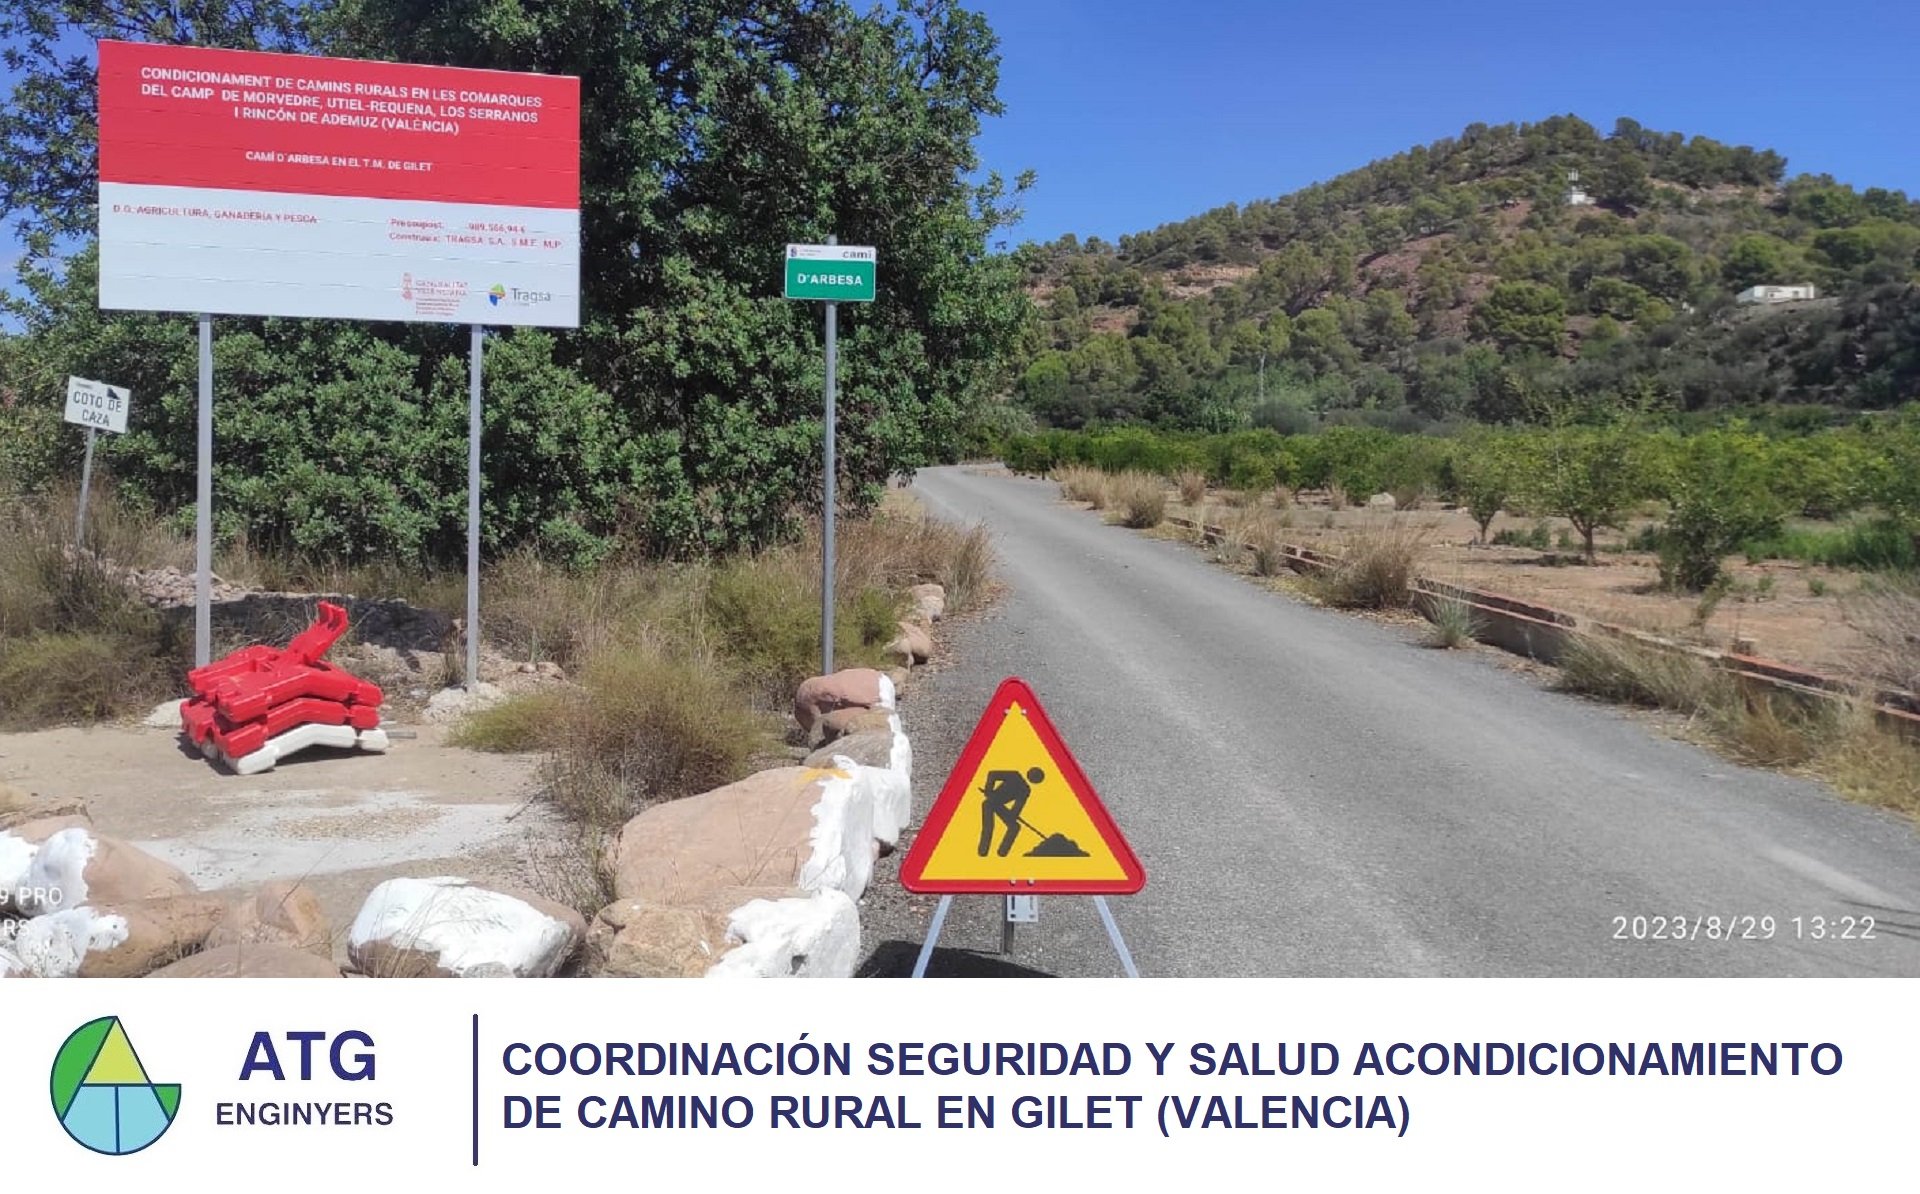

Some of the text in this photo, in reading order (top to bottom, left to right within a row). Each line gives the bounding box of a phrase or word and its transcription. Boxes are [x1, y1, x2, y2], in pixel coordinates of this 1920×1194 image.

[141, 67, 542, 107] CONDICIONAMENT DE CAMINS RURALS EN LES COMARQUES
[141, 83, 538, 122] DEL CAMP DE MORVEDRE, UTIEL-REQUENA, LOS SERRANOS
[234, 106, 239, 118] I
[243, 107, 296, 122] RINCÓN
[299, 112, 318, 124] DE
[321, 113, 378, 128] ADEMUZ
[331, 156, 347, 166] EN
[348, 157, 361, 167] EL
[387, 159, 402, 170] DE
[404, 160, 433, 171] GILET
[275, 213, 281, 221] Y
[284, 214, 318, 224] PESCA
[446, 234, 483, 245] TRAGSA
[797, 272, 863, 286] D'ARBESA
[511, 287, 551, 303] Tragsa
[73, 391, 122, 413] COTO DE
[82, 409, 110, 427] CAZA
